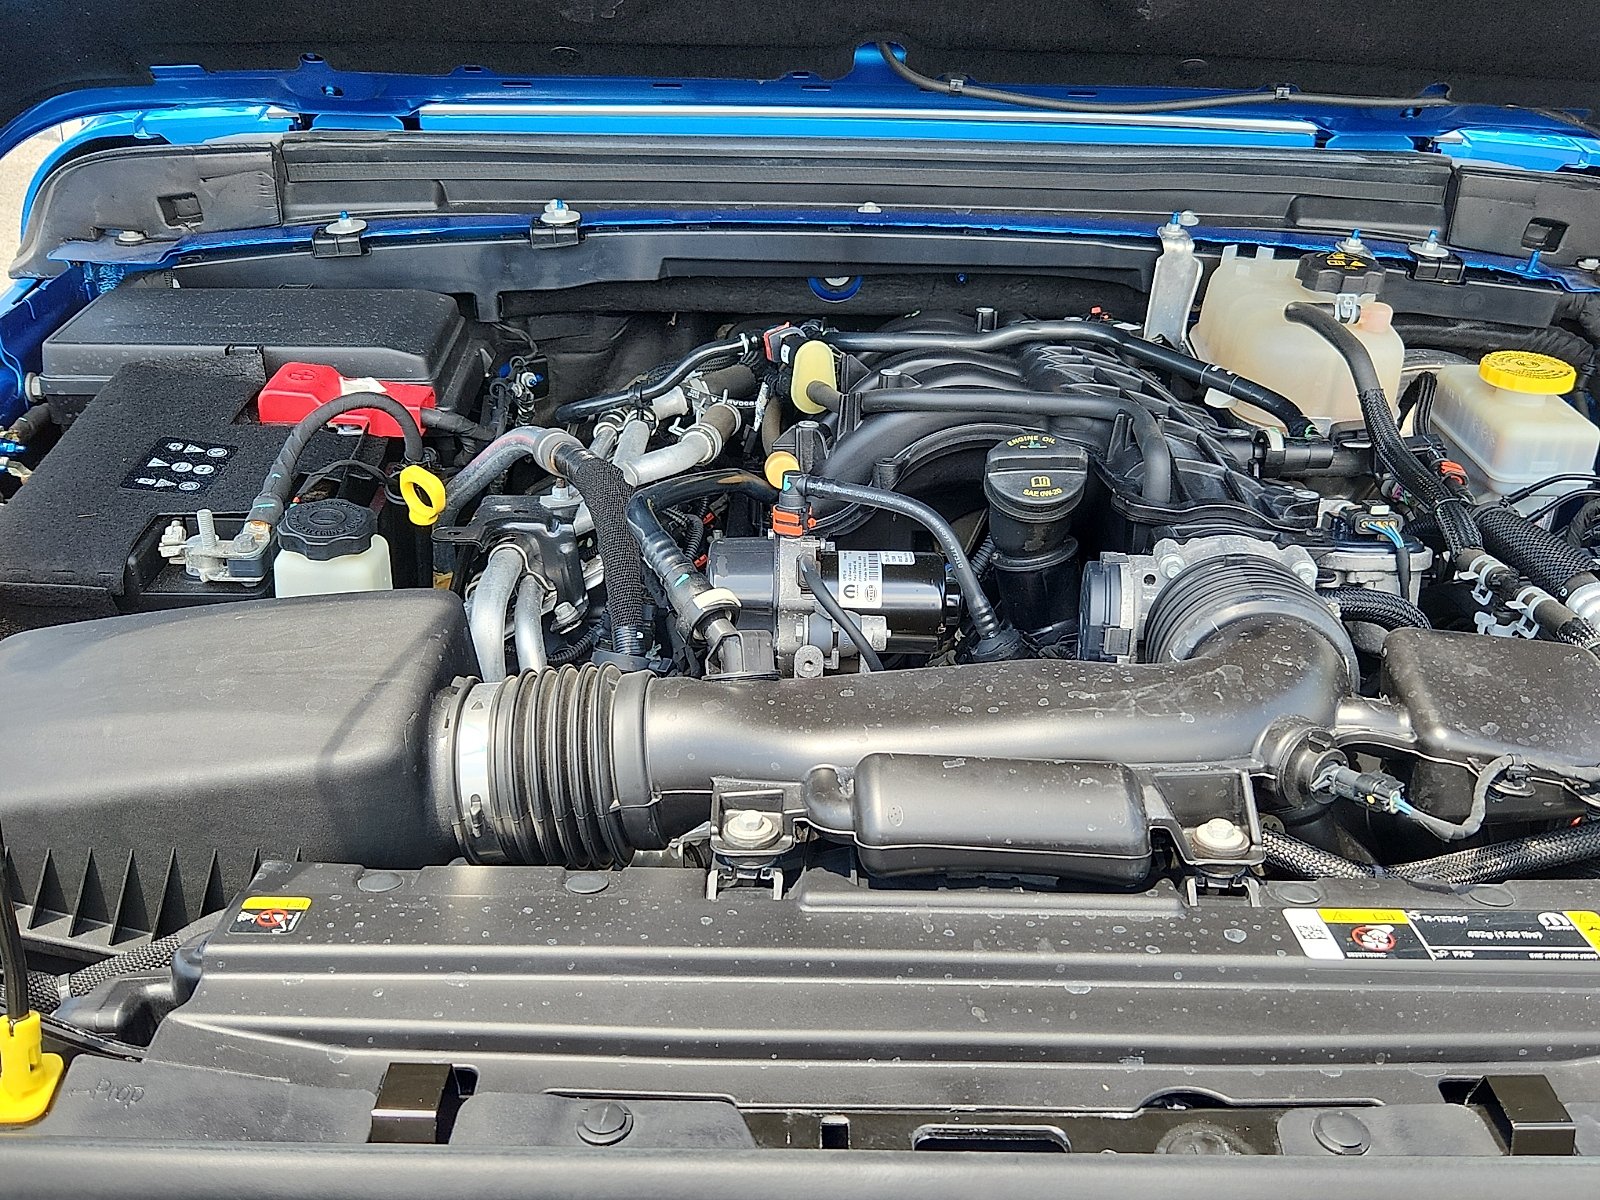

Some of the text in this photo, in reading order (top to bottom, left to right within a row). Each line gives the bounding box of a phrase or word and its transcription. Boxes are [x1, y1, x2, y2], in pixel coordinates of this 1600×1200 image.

[1007, 435, 1056, 447] ENGINE OIL
[1022, 487, 1063, 498] SAE 0W-20
[91, 1078, 145, 1110] Prop
